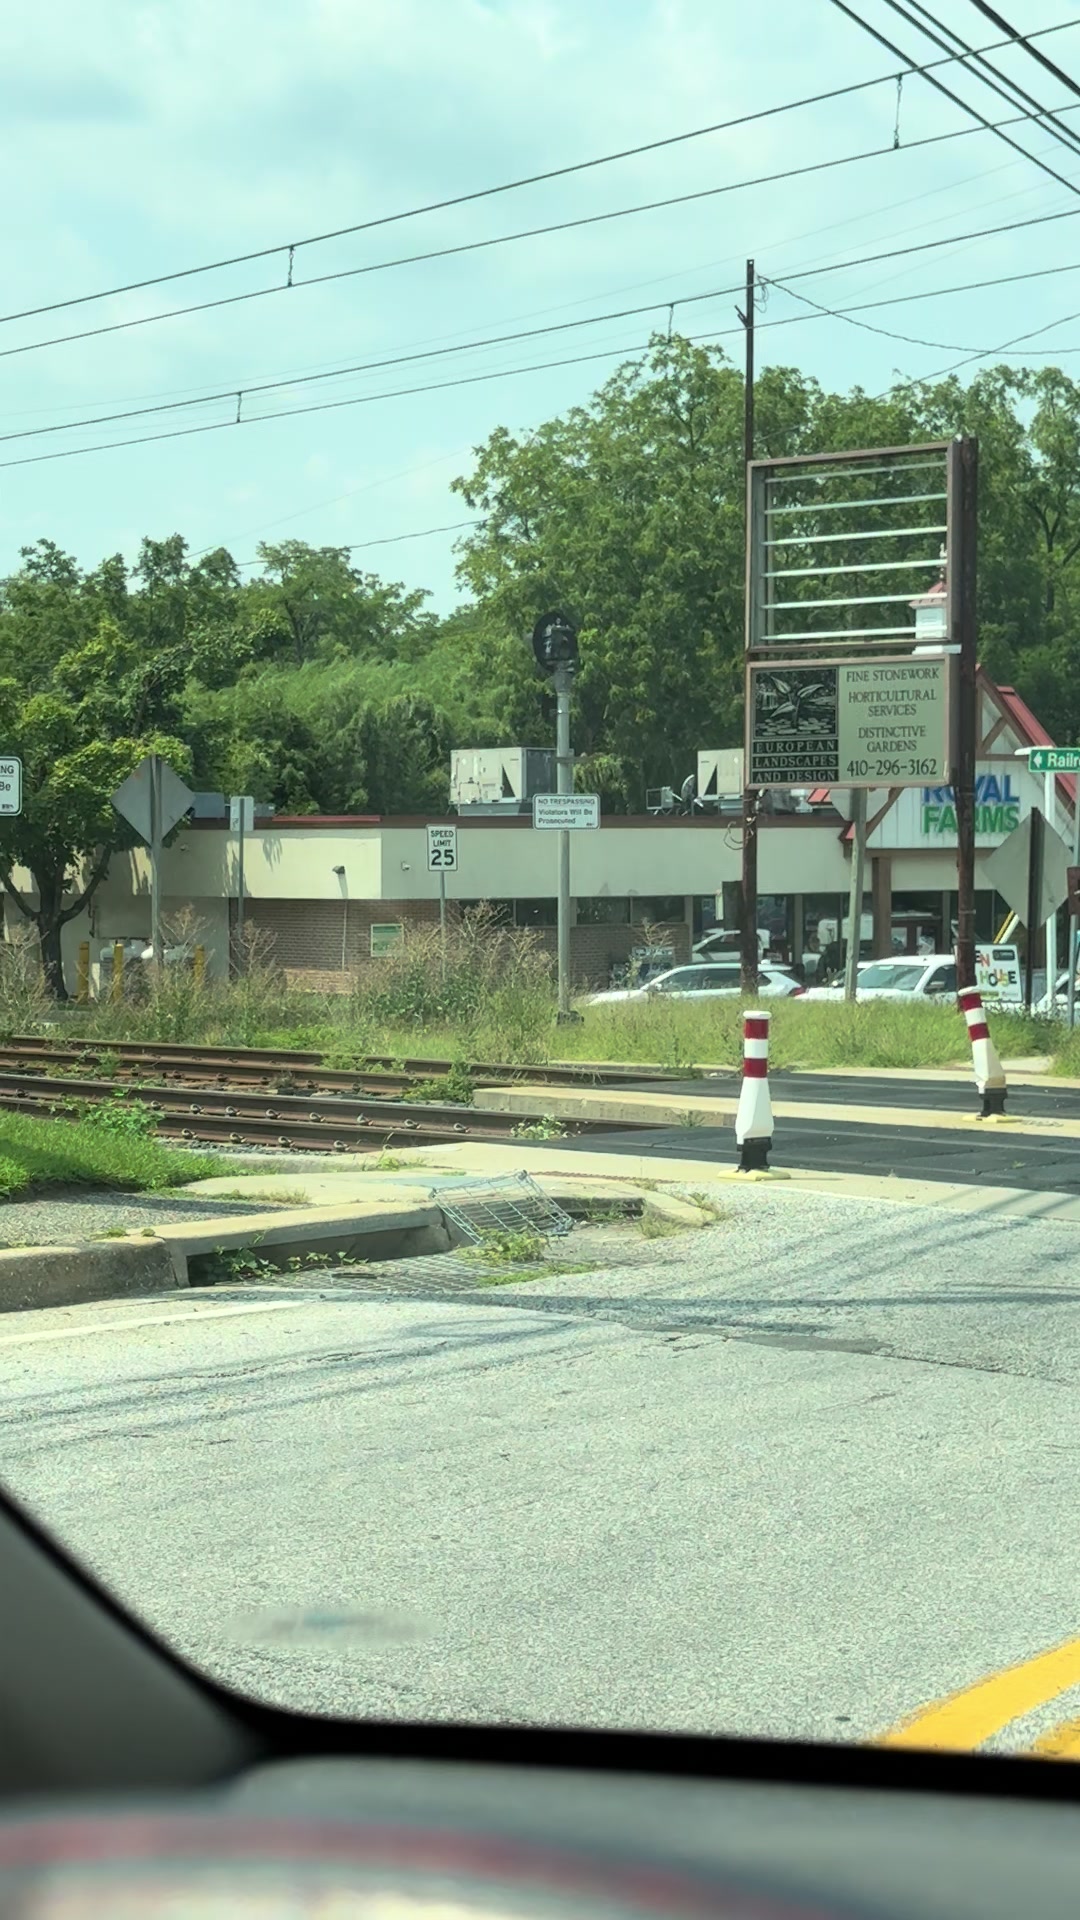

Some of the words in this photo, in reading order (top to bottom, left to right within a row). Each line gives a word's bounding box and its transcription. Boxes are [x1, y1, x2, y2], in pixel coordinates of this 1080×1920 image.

[846, 671, 870, 682] FINE
[872, 668, 940, 681] STONEWORK
[848, 689, 937, 703] HORTICULTURAL
[868, 704, 917, 717] SERVICES
[858, 725, 926, 739] DISTINCTIVE
[756, 742, 836, 752] EUROPEAN
[866, 740, 917, 753] GARDENS
[755, 756, 837, 768] LANDSCAPES
[1047, 752, 1080, 768] Railr
[846, 758, 937, 777] 410-296-3162
[756, 772, 781, 782] AND
[787, 769, 836, 781] DESIGN
[923, 806, 1020, 833] FAMS
[431, 849, 454, 866] 25
